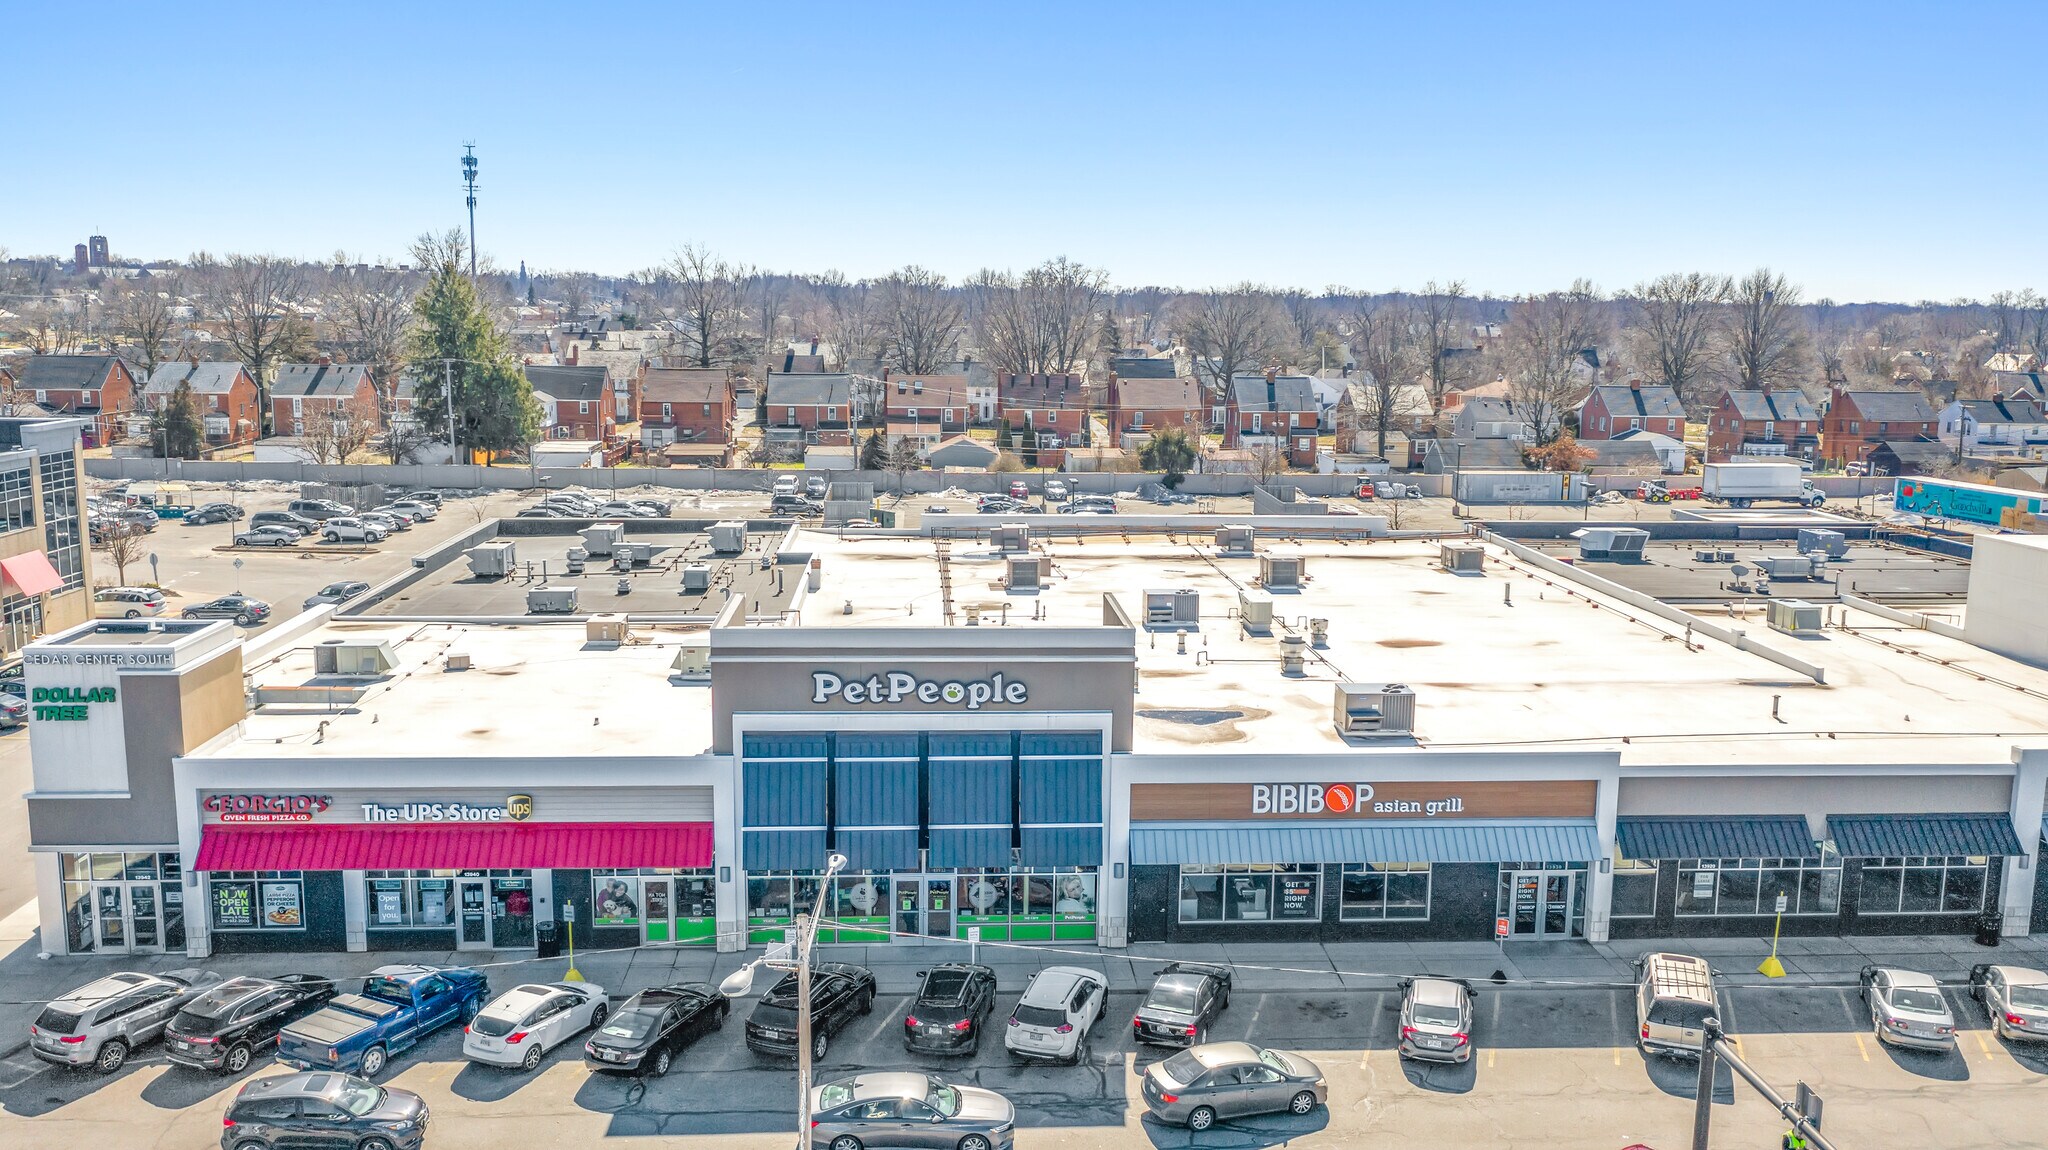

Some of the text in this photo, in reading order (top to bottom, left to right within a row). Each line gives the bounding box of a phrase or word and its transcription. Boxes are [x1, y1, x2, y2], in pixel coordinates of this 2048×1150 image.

[23, 653, 174, 665] CEDAR CENTER SOUTH
[32, 687, 116, 703] DOLLAR
[812, 672, 1027, 708] PetPeople
[33, 705, 88, 721] TREE
[203, 795, 331, 813] GEORGIO'S
[1253, 784, 1463, 816] BIBIBOP asian grill
[361, 803, 501, 822] The UPS Store
[510, 804, 530, 819] ups
[379, 894, 400, 903] Open
[220, 907, 250, 916] LATE
[384, 903, 396, 911] for
[381, 912, 399, 920] you.
